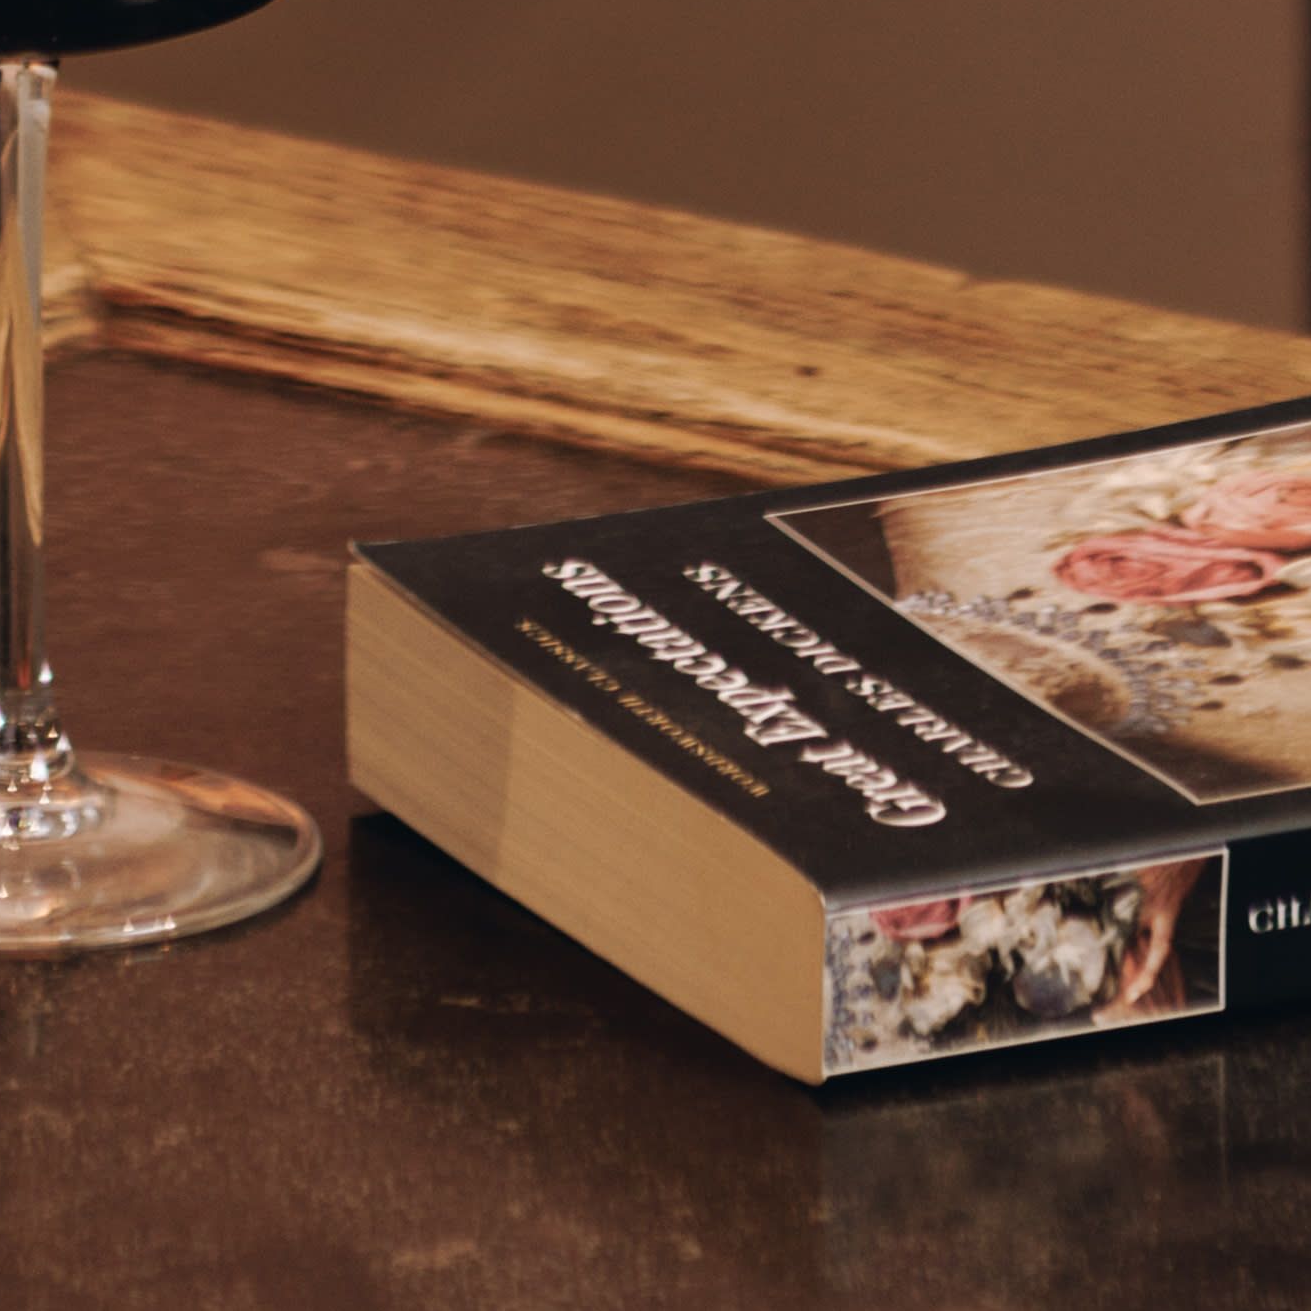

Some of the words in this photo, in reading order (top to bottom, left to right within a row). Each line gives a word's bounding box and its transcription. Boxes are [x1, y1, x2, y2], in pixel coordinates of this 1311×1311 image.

[542, 558, 829, 747] Expectations
[683, 562, 862, 675] DICKENS
[800, 740, 946, 827] Great
[846, 675, 1034, 788] CHARLES
